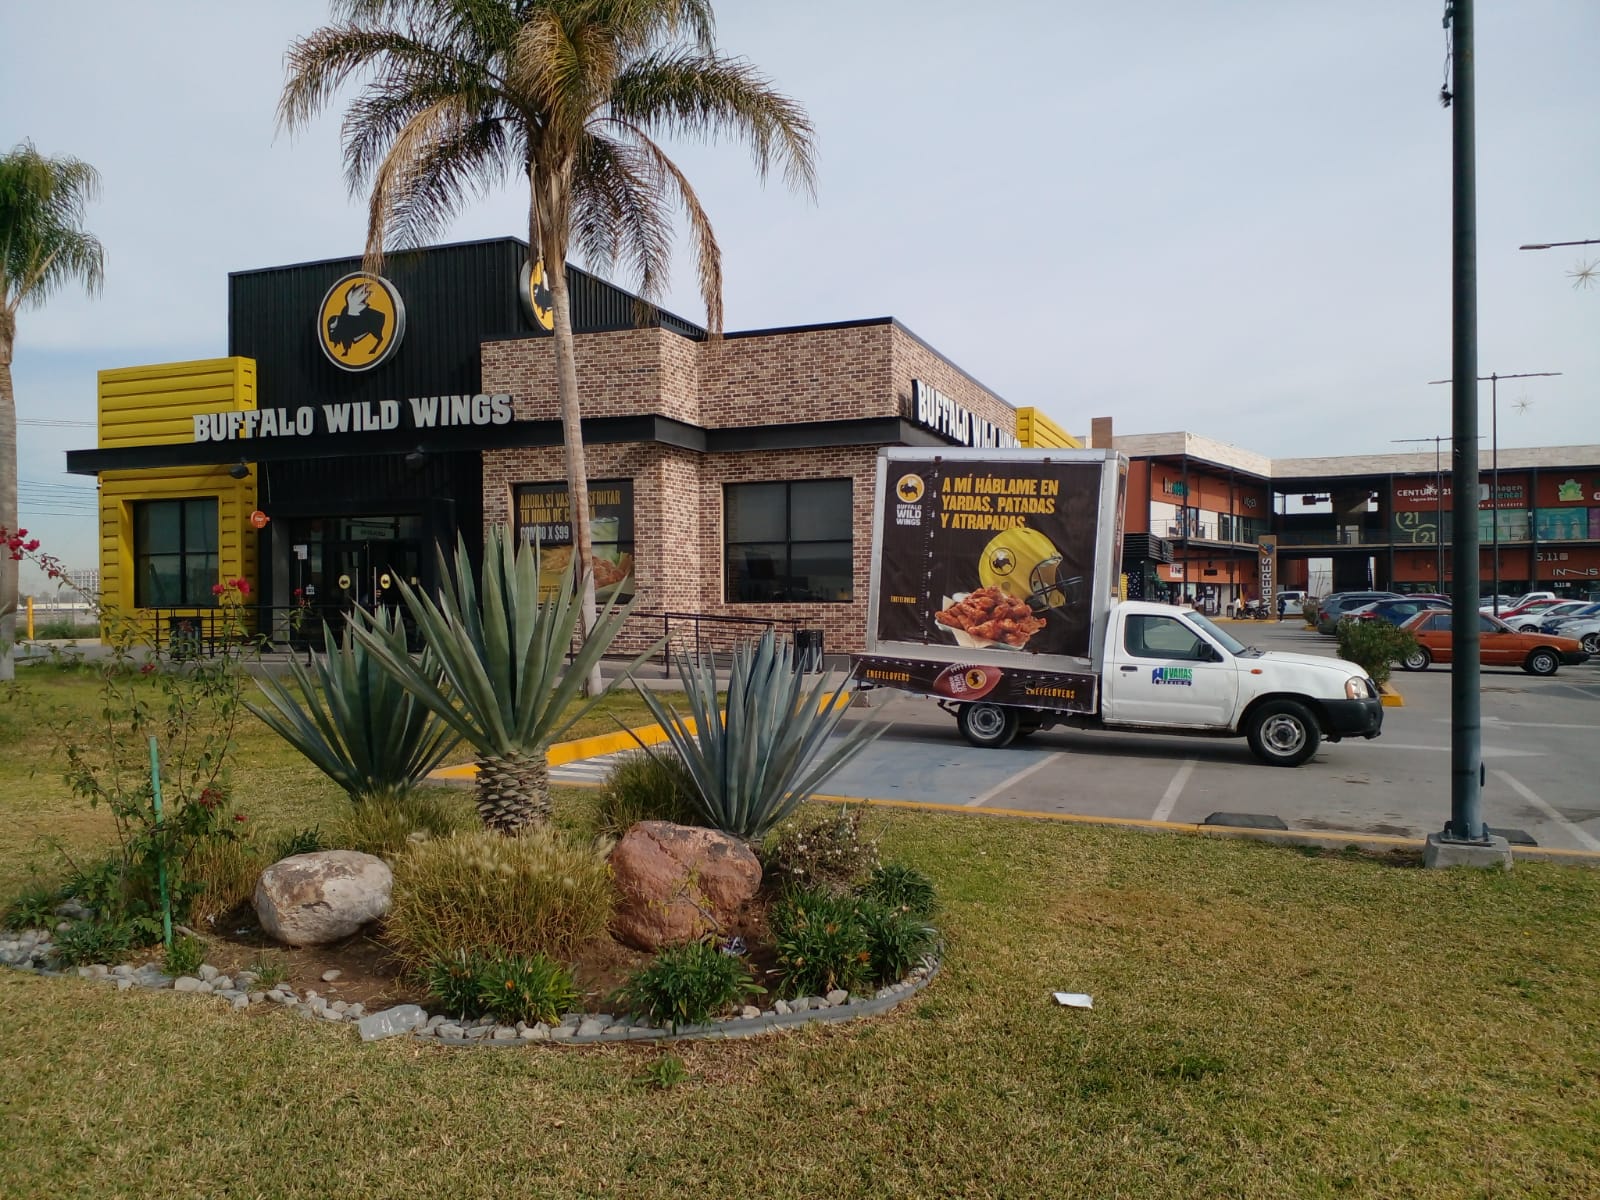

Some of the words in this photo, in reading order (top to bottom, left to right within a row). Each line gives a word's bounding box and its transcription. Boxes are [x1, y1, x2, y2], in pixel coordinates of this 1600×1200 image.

[193, 406, 315, 442] BUFFALO
[323, 400, 401, 433] WILD
[409, 394, 513, 428] WINGS
[911, 379, 970, 446] BUFFALO
[942, 477, 951, 493] A
[953, 473, 973, 494] MÍ
[974, 473, 1038, 496] HÁBLAME
[1040, 480, 1059, 496] EN
[1396, 487, 1438, 497] CENTURY
[1442, 488, 1451, 496] 21
[520, 493, 544, 509] AHORA
[941, 495, 994, 513] YARDAS,
[997, 497, 1056, 514] PATADAS
[520, 509, 530, 523] TU
[531, 508, 552, 523] HORA
[896, 510, 922, 519] WILD
[896, 518, 921, 526] WINGS
[941, 513, 949, 529] Y
[951, 514, 1026, 531] ATRAPADAS
[1404, 511, 1419, 524] 21
[555, 525, 569, 542] $99
[1421, 531, 1436, 543] 21
